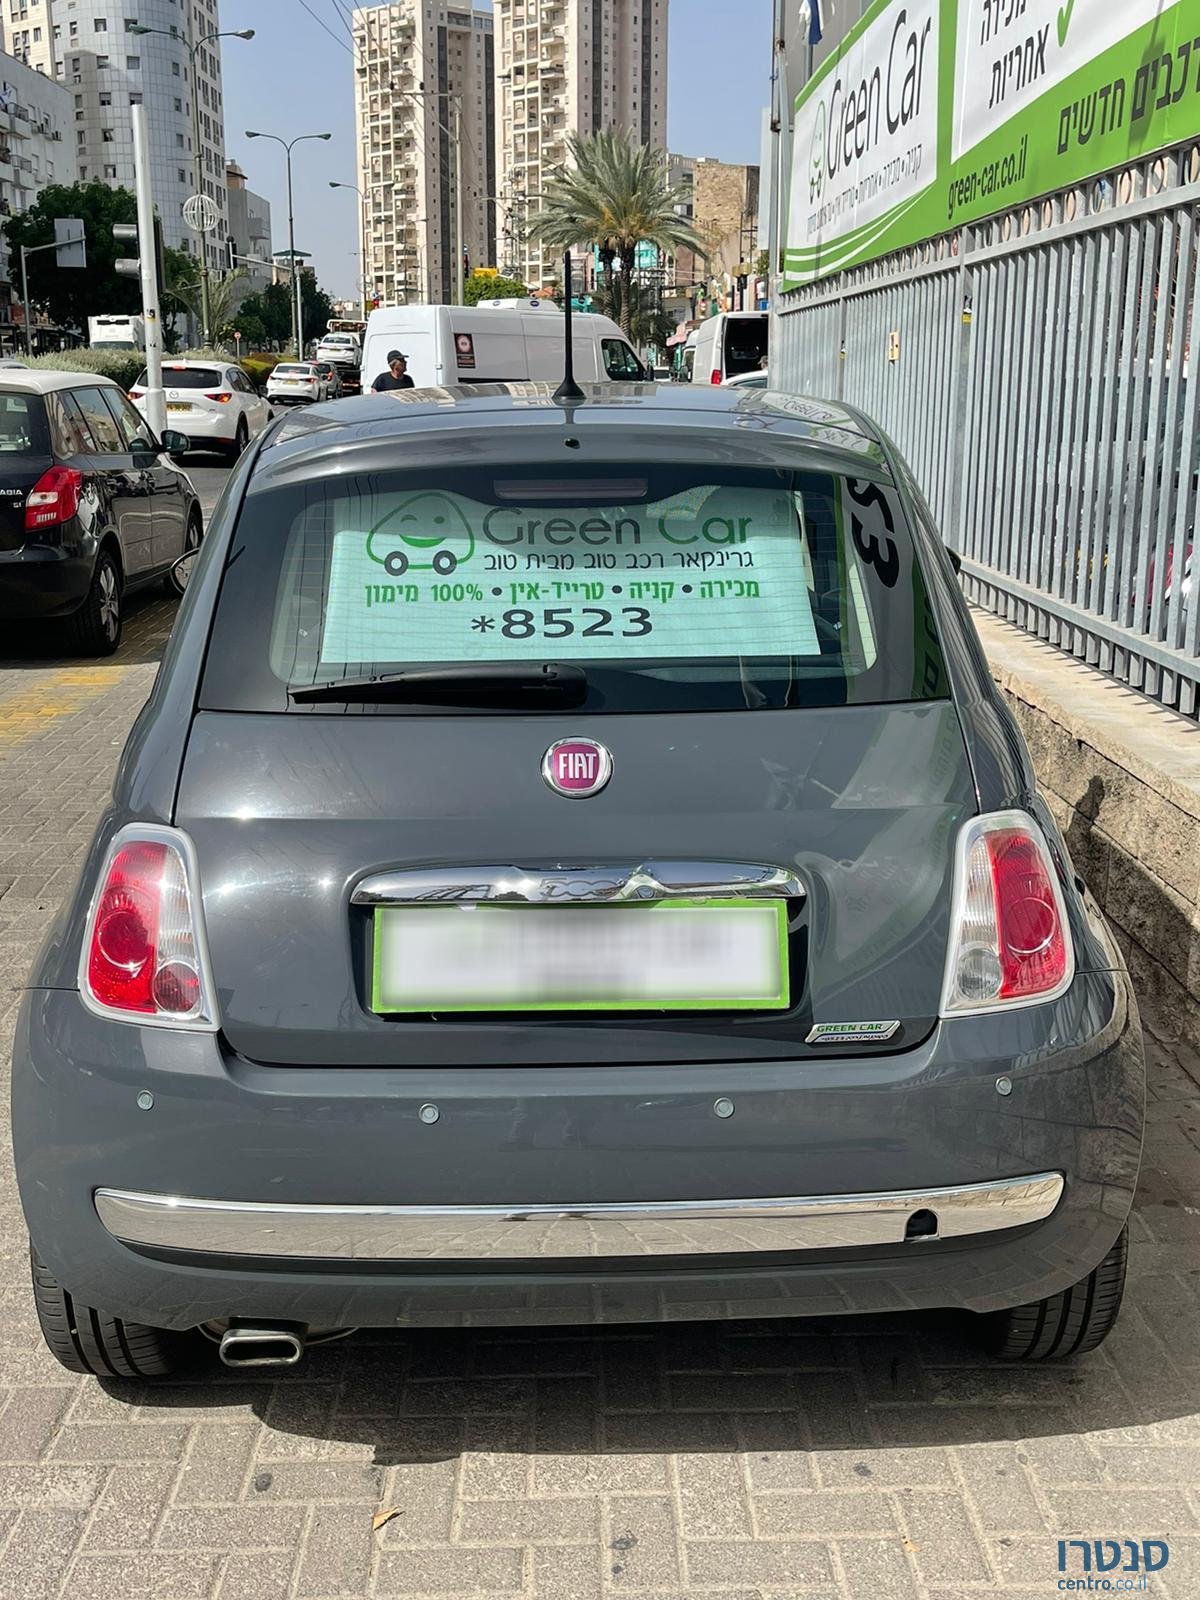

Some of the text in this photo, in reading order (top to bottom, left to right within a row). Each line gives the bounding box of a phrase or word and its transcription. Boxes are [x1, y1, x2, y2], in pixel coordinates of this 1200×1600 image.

[989, 23, 1050, 109] אחריות
[827, 9, 932, 179] Green Car
[1057, 78, 1126, 155] חדשים
[948, 133, 1028, 220] green-car.co.il
[483, 505, 753, 545] Green Car
[484, 550, 754, 571] גרינקאר רכב טוב מבית טוב
[364, 579, 760, 608] מכירה קניה טרייד-אין 100% מימון
[558, 752, 597, 779] FIAT
[859, 1023, 884, 1031] CAR
